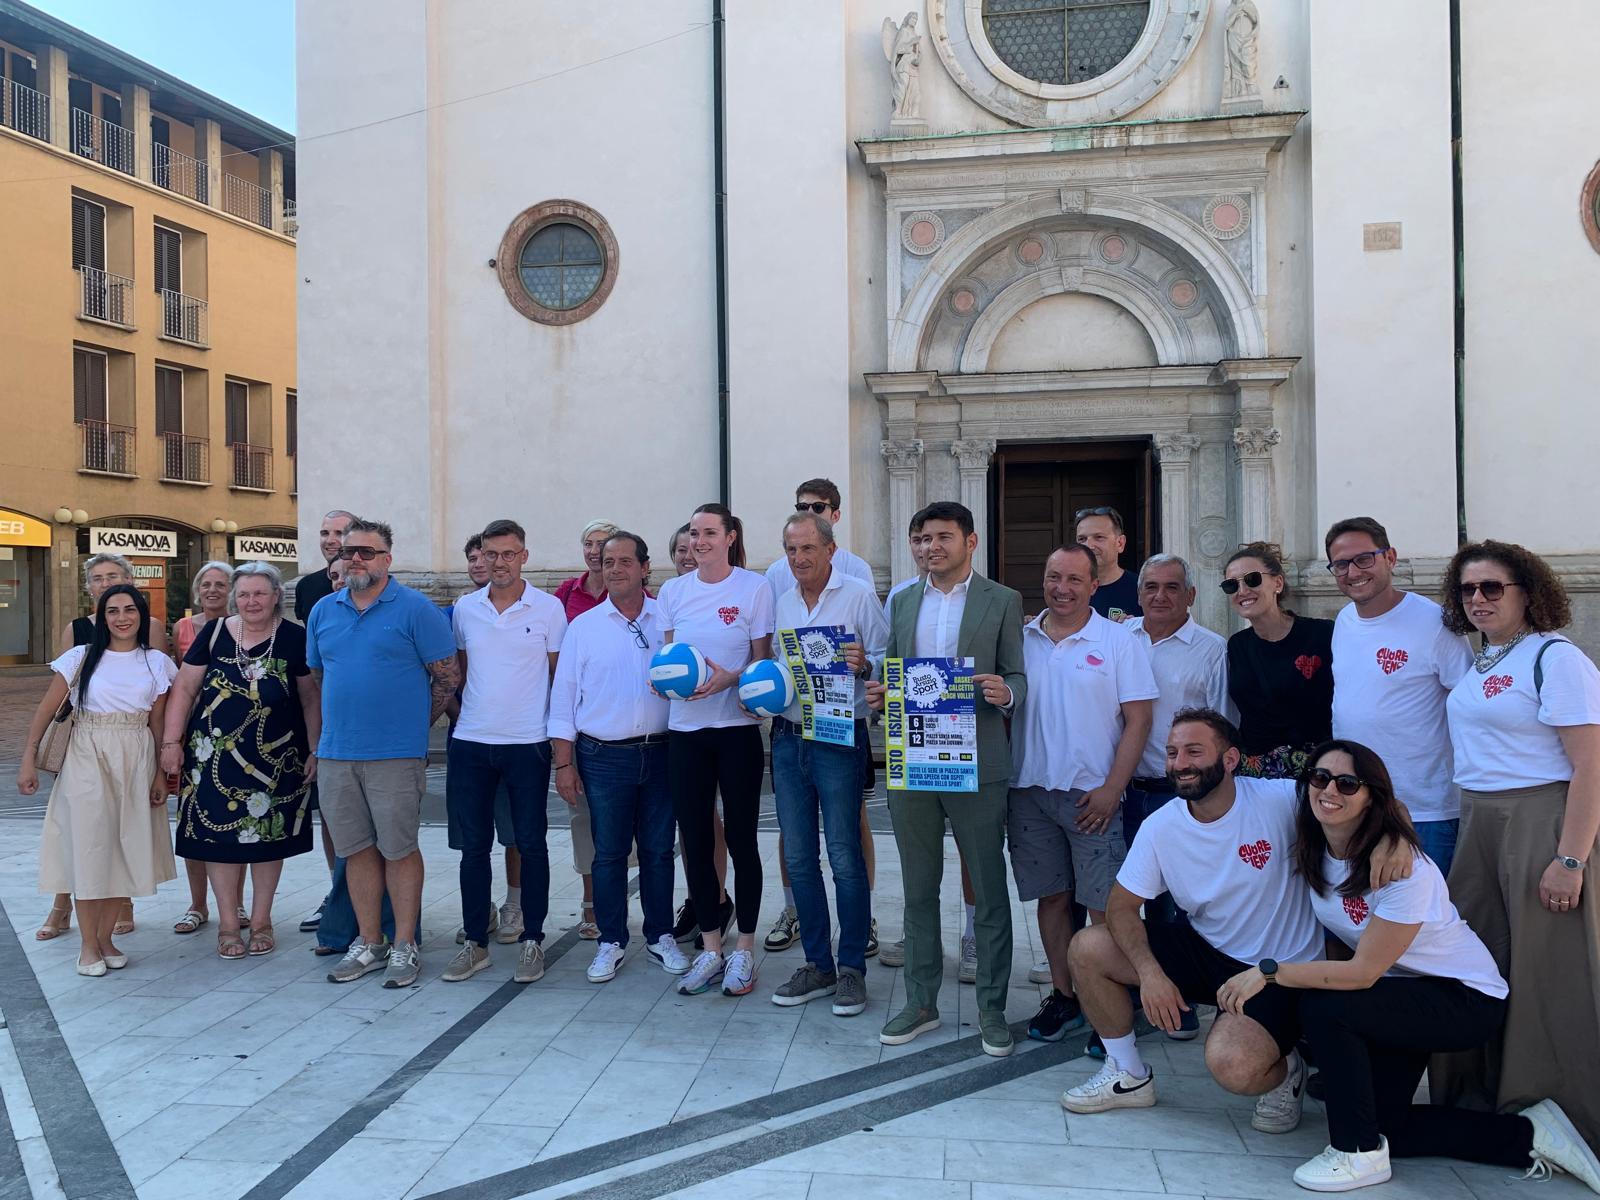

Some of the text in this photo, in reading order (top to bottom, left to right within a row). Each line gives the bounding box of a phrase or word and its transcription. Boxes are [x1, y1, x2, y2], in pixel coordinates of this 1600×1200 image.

[97, 531, 171, 549] KASANOVA
[240, 540, 297, 555] KASANOVA
[1376, 648, 1408, 662] CUORE
[815, 677, 821, 686] 6
[887, 661, 902, 698] SPORT
[1483, 674, 1513, 687] CUORE
[912, 681, 939, 696] Sport
[948, 684, 974, 692] CALCETTO
[816, 691, 824, 701] 12
[957, 692, 975, 700] VOLLEY
[913, 717, 920, 728] 6
[911, 734, 922, 744] 12
[1239, 840, 1272, 857] CUORE
